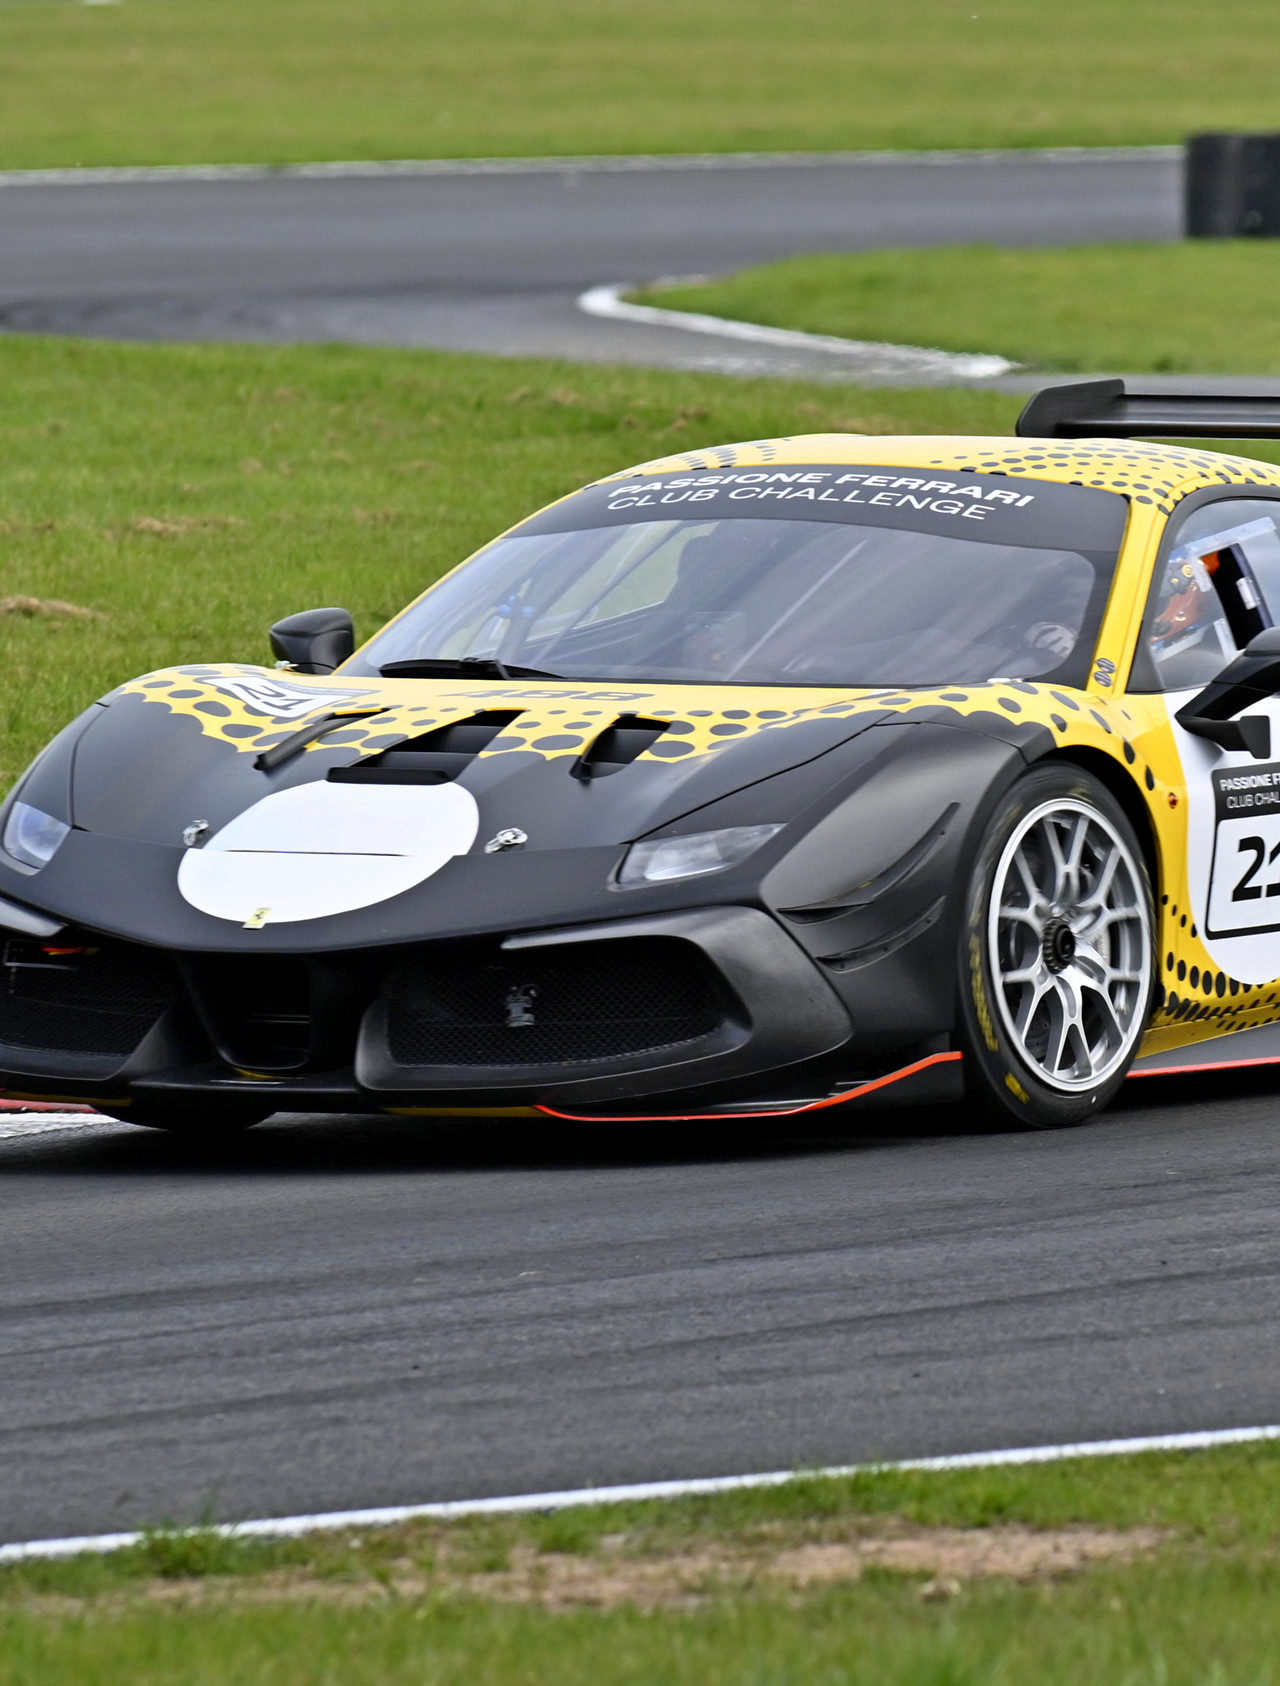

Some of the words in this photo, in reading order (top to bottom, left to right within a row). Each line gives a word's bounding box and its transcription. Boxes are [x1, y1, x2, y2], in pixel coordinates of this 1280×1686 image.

[607, 472, 824, 498] PASSIONE
[834, 473, 1036, 507] FERRARI
[607, 486, 720, 511] CLUB
[728, 485, 997, 520] CHALLENGE
[232, 683, 316, 712] 21
[435, 689, 656, 702] 488
[1220, 773, 1273, 791] PASSIONE
[1226, 793, 1254, 809] CLUB
